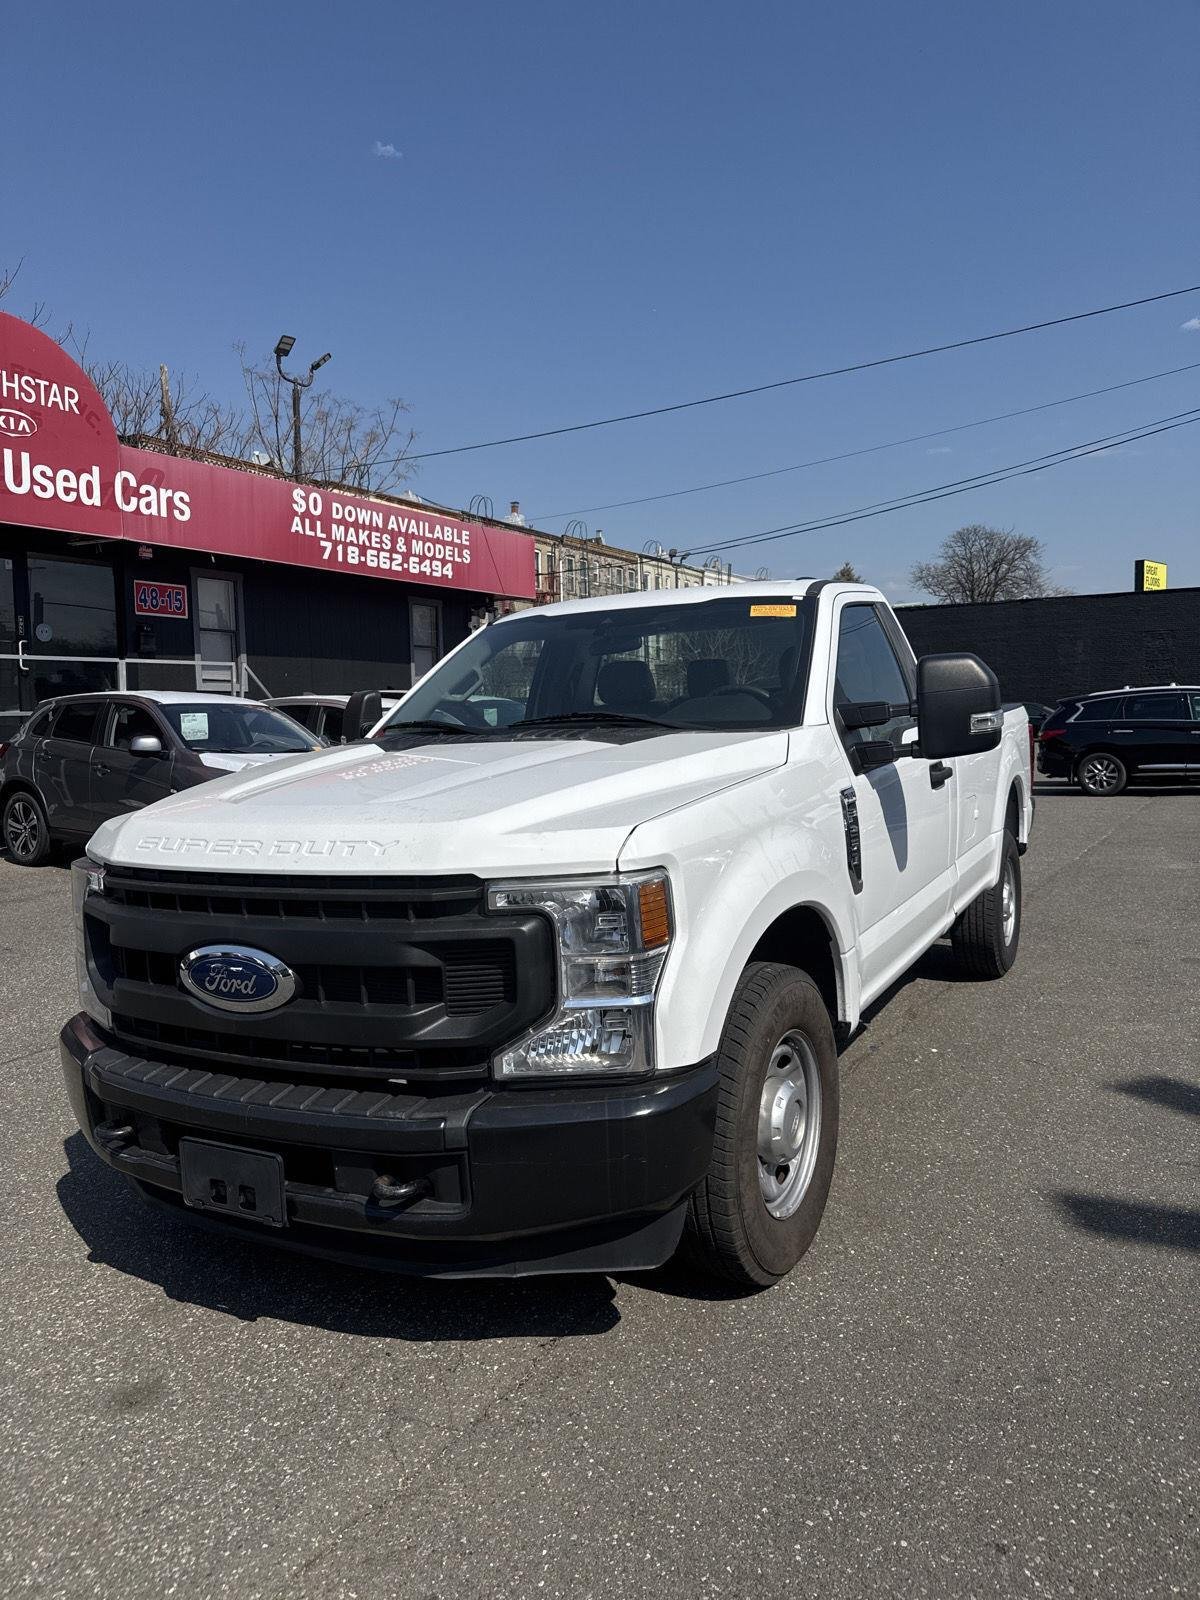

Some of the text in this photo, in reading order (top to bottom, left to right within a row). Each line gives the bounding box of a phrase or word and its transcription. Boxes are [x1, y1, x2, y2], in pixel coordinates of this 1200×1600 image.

[0, 369, 80, 415] HSTAR
[4, 449, 191, 522] Used Cars
[292, 487, 470, 546] $0 DOWN AVAILABLE
[290, 516, 471, 564] ALL MAKES & MODELS
[319, 540, 453, 579] 718-662-6494
[1145, 564, 1158, 576] GREAT
[138, 586, 183, 612] 48-15
[1145, 575, 1160, 588] FLOORS
[135, 836, 400, 857] SUPER DUTY
[204, 963, 257, 995] Ford
